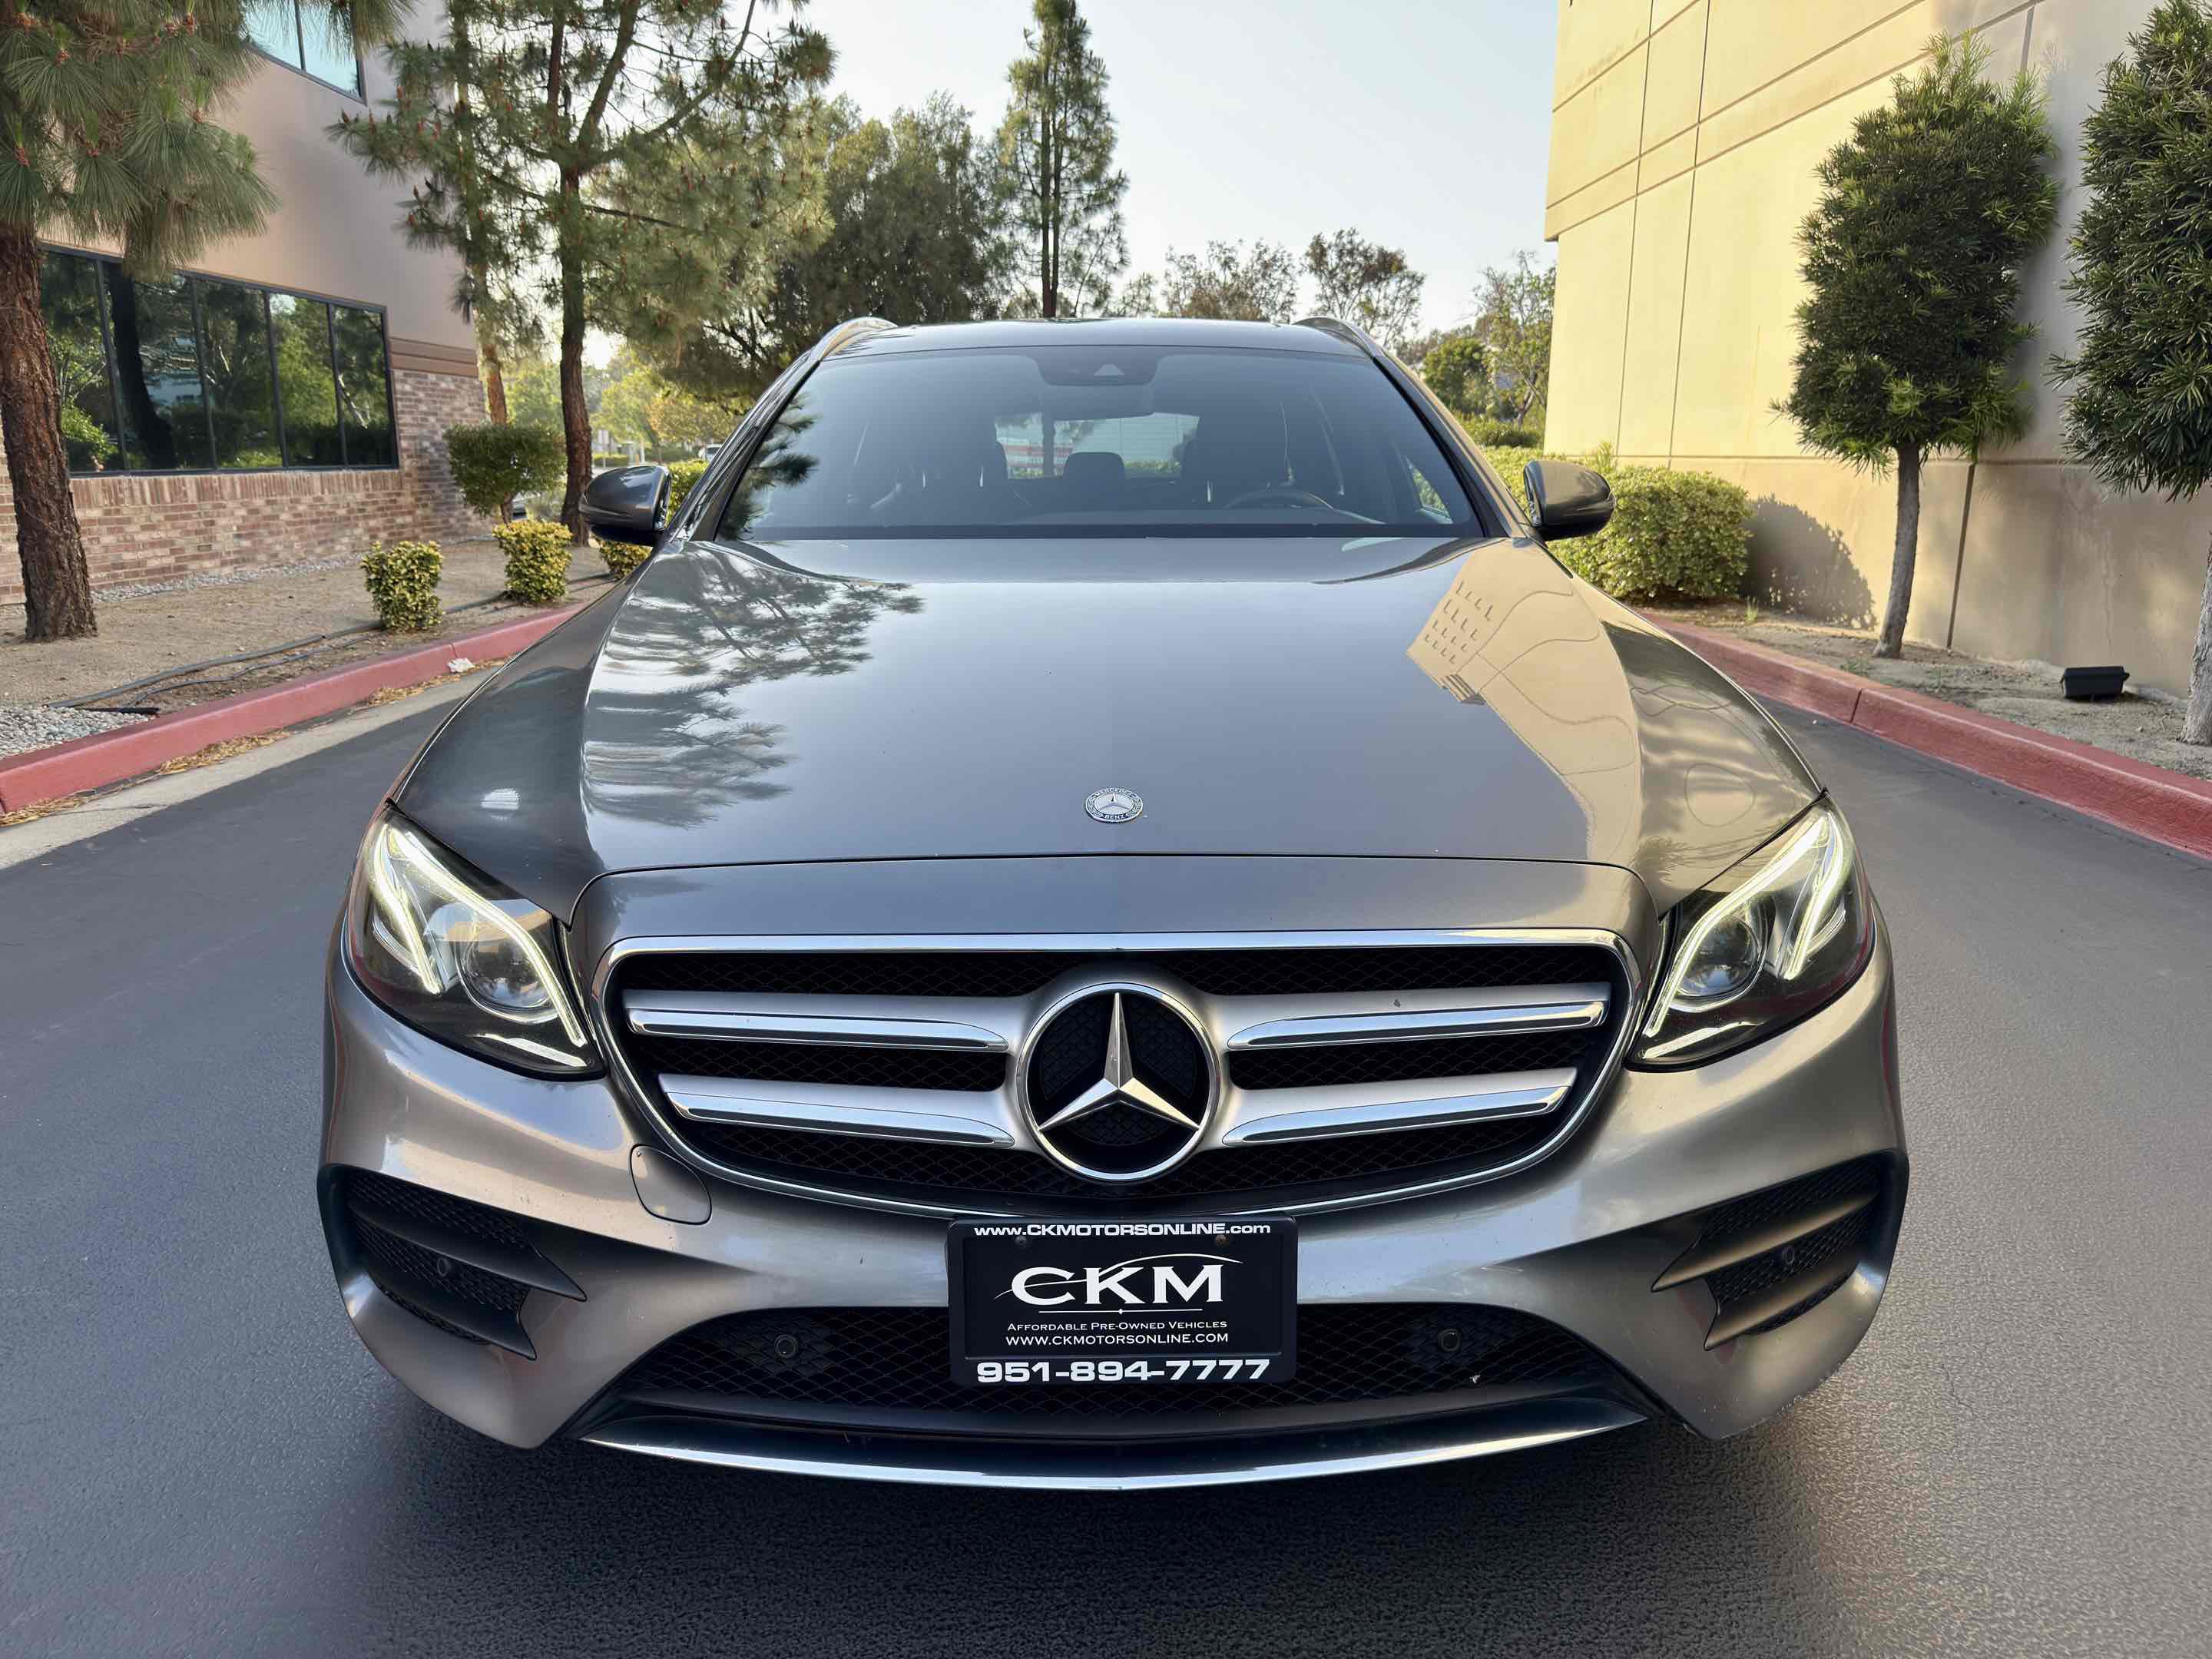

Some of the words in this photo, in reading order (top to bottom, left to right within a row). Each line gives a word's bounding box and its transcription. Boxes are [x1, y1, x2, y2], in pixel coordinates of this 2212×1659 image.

[974, 1223, 1271, 1236] www.CKMOTORSONLINE.com
[1011, 1264, 1224, 1306] CKM
[1007, 1323, 1088, 1331] AFFORDABLE
[1091, 1321, 1165, 1330] PRE-OWNED
[1168, 1320, 1227, 1330] VEHICLES
[1005, 1333, 1229, 1346] WWW.CKMOTORSONLINE.COM
[976, 1359, 1270, 1383] 951-894-7777
